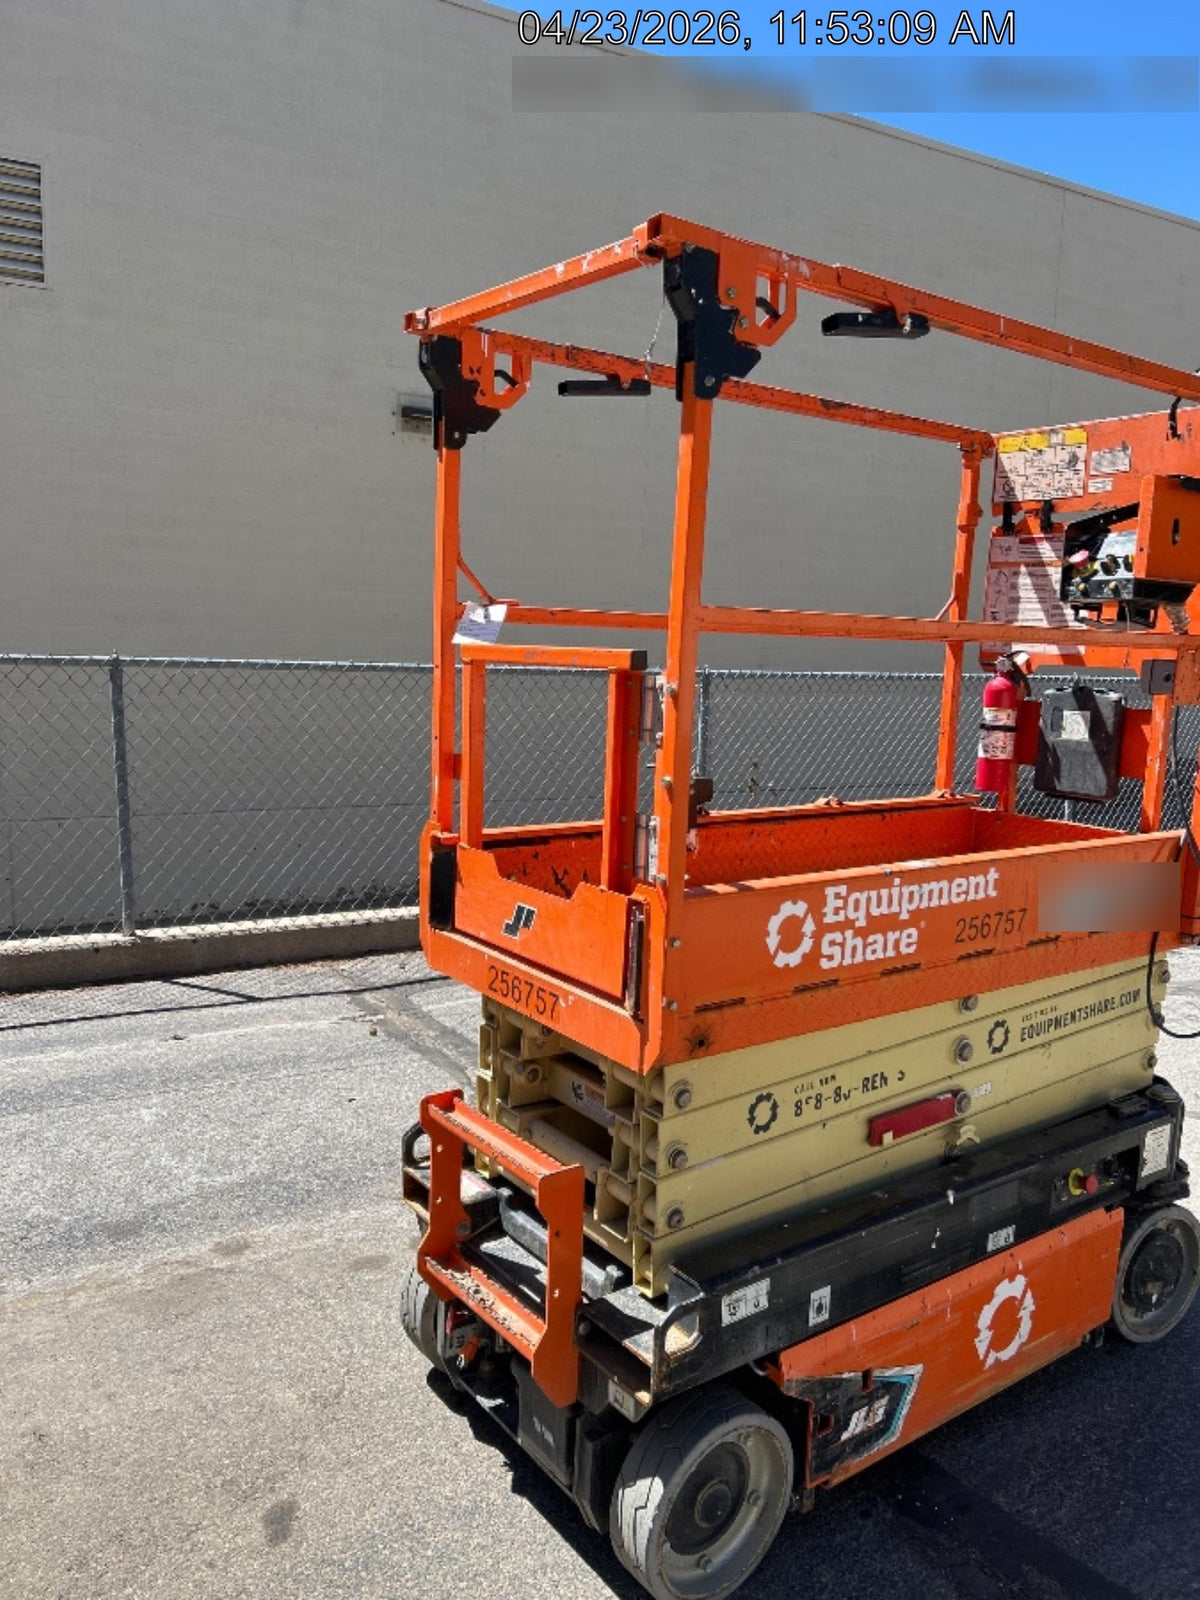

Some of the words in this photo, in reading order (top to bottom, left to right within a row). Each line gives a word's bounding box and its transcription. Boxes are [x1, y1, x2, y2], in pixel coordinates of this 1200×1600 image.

[822, 866, 999, 928] Equipment
[819, 926, 919, 970] Share
[954, 907, 1029, 944] 256757
[488, 964, 560, 1020] 256757
[1019, 987, 1142, 1043] EQUIPMENTSHARE.COM
